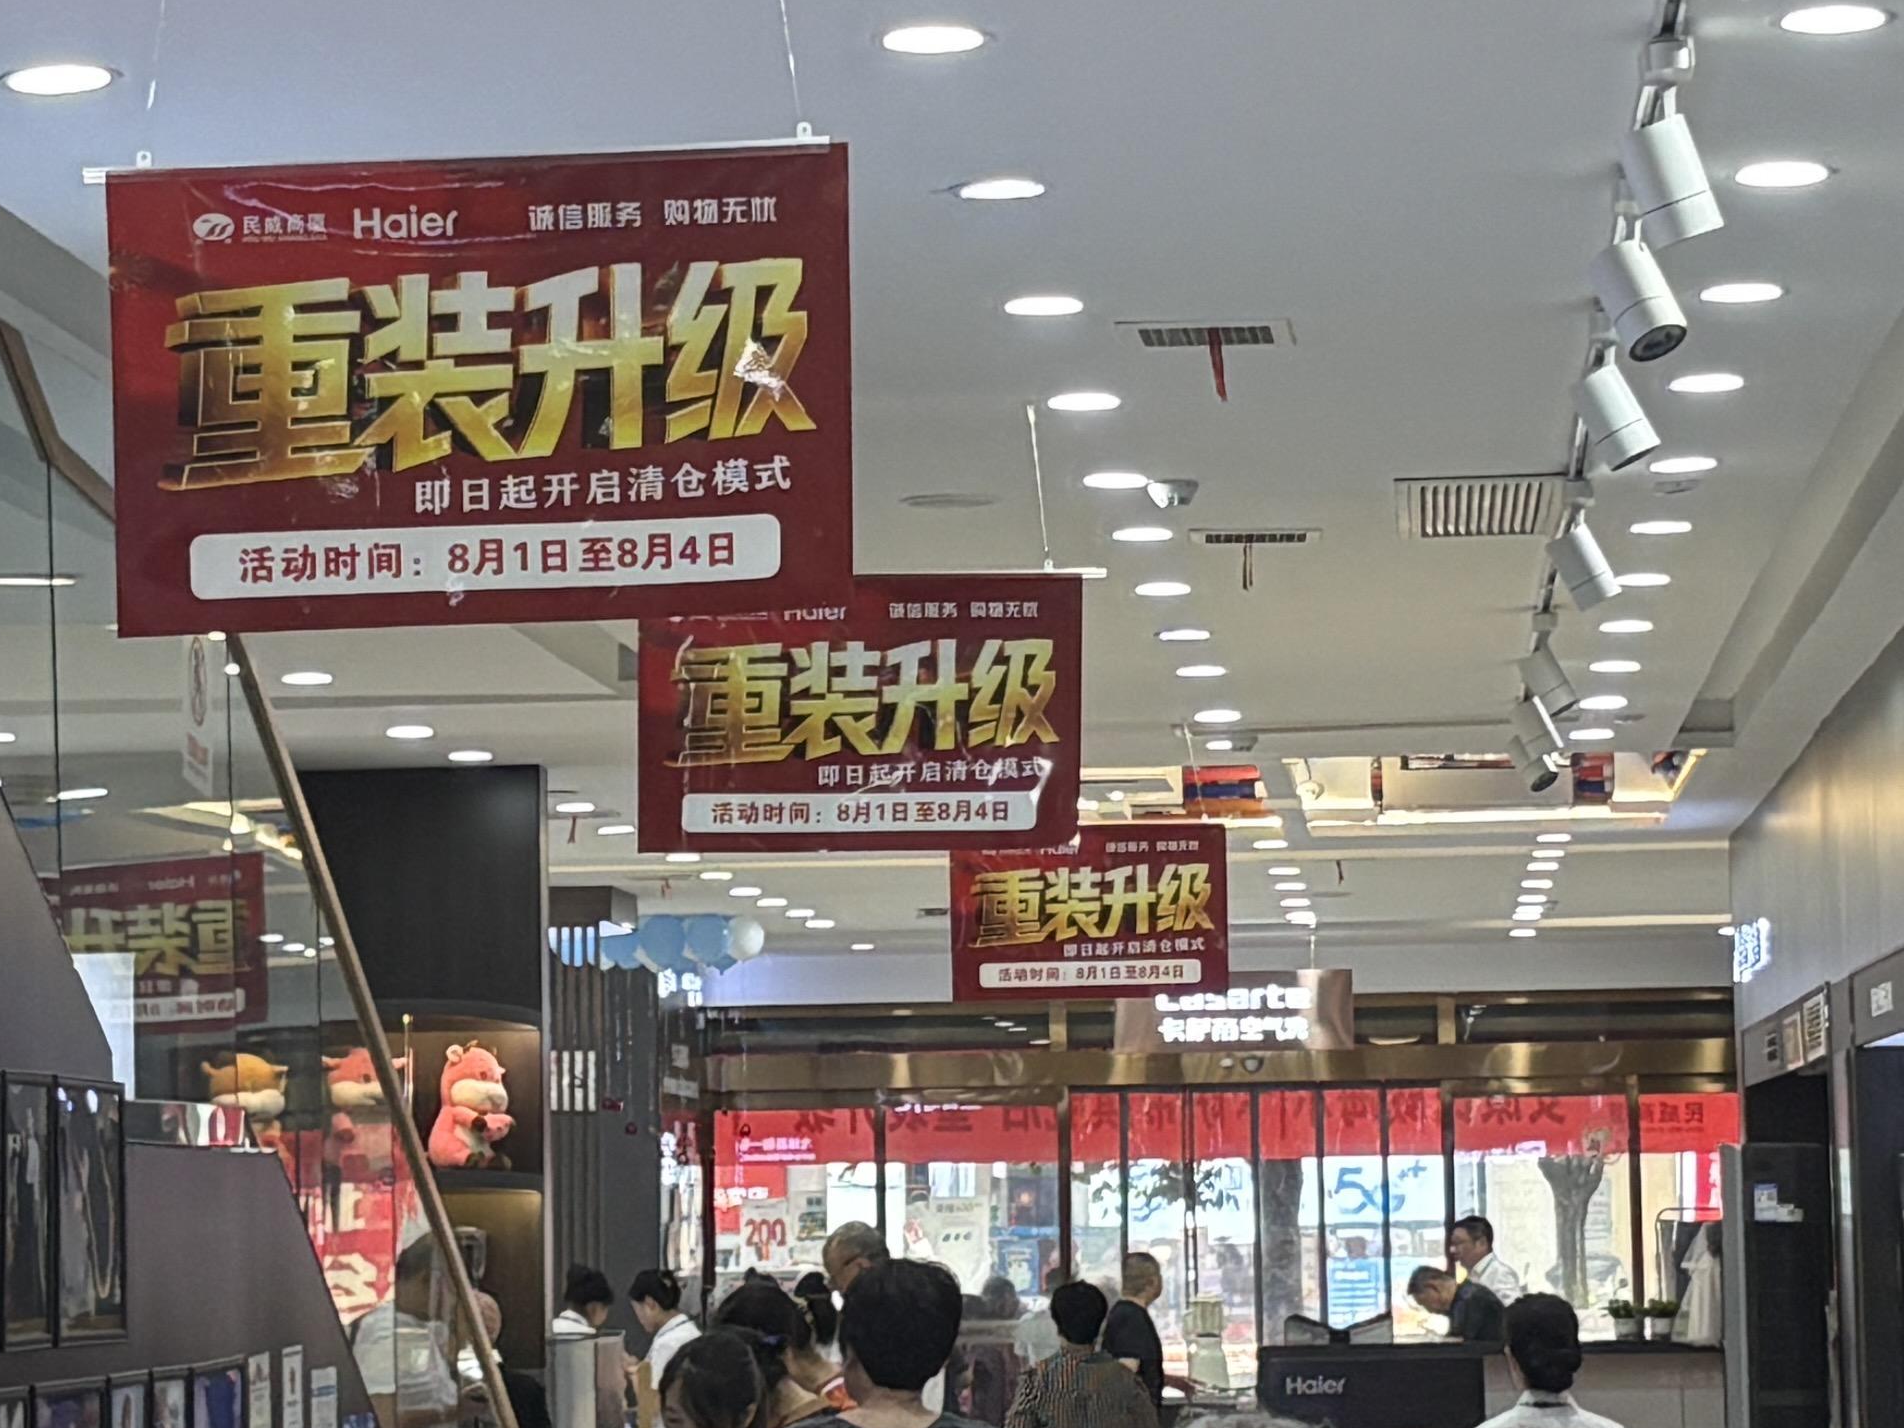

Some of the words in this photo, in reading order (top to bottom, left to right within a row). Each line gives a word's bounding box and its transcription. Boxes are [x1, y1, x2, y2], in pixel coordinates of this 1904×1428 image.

[242, 212, 327, 235] 民威商厦
[352, 204, 459, 240] Haier
[528, 200, 642, 232] 诚信服务
[663, 195, 777, 227] 购物无忧
[156, 258, 817, 491] 重装升级
[414, 455, 793, 516] 即日起开启清仓模式
[664, 638, 1060, 768] 重装升级
[817, 758, 1044, 787] 即日起开启清仓模式
[969, 863, 1215, 948] 重装升级
[1285, 1376, 1347, 1396] Haier
